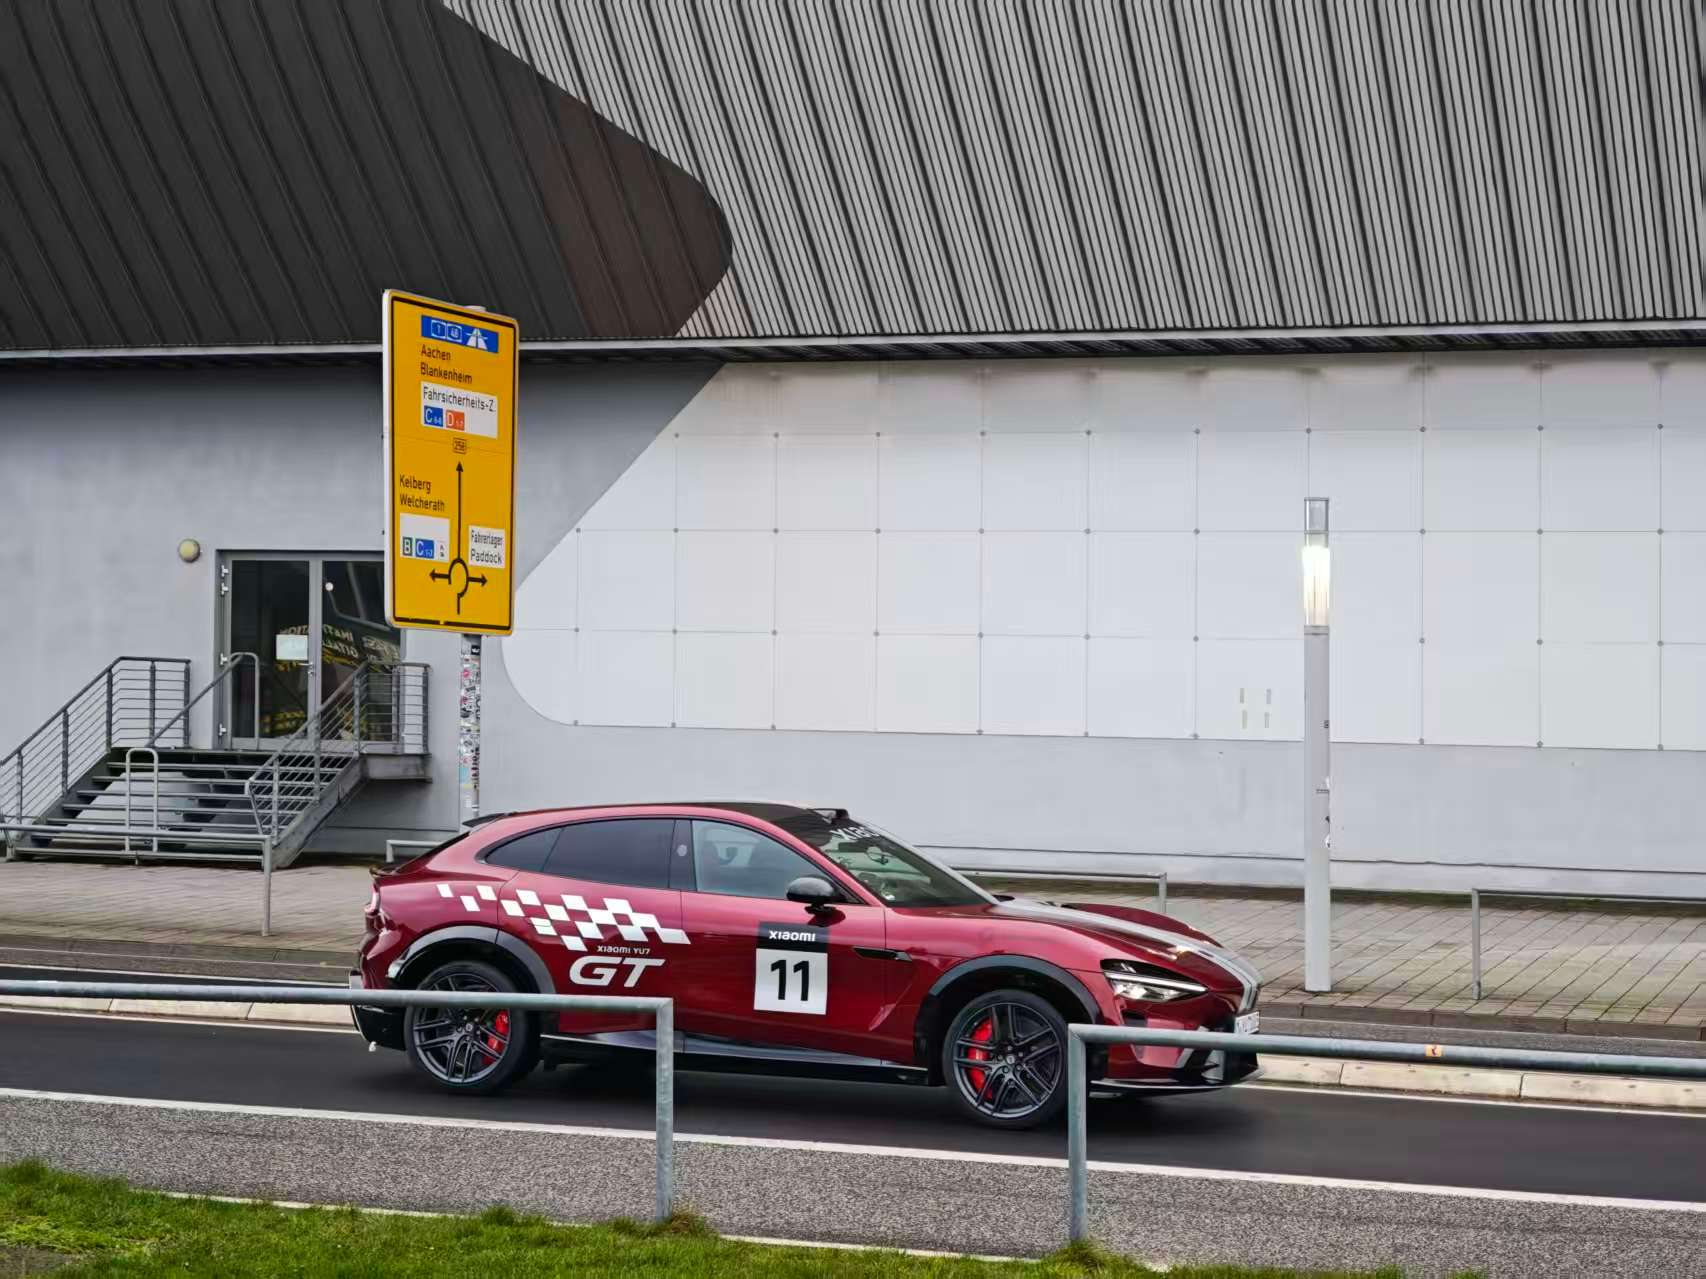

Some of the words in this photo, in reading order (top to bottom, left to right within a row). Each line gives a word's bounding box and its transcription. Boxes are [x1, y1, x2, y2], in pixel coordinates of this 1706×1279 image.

[421, 344, 451, 361] Aachen
[420, 361, 473, 384] Blankenheim
[400, 473, 432, 494] Kelberg
[400, 493, 445, 512] Welcherath
[404, 539, 411, 554] B
[471, 529, 503, 548] Fahrerlager
[471, 548, 503, 565] Paddock
[633, 947, 651, 955] YU7
[569, 955, 667, 988] GT
[770, 959, 810, 1002] 11
